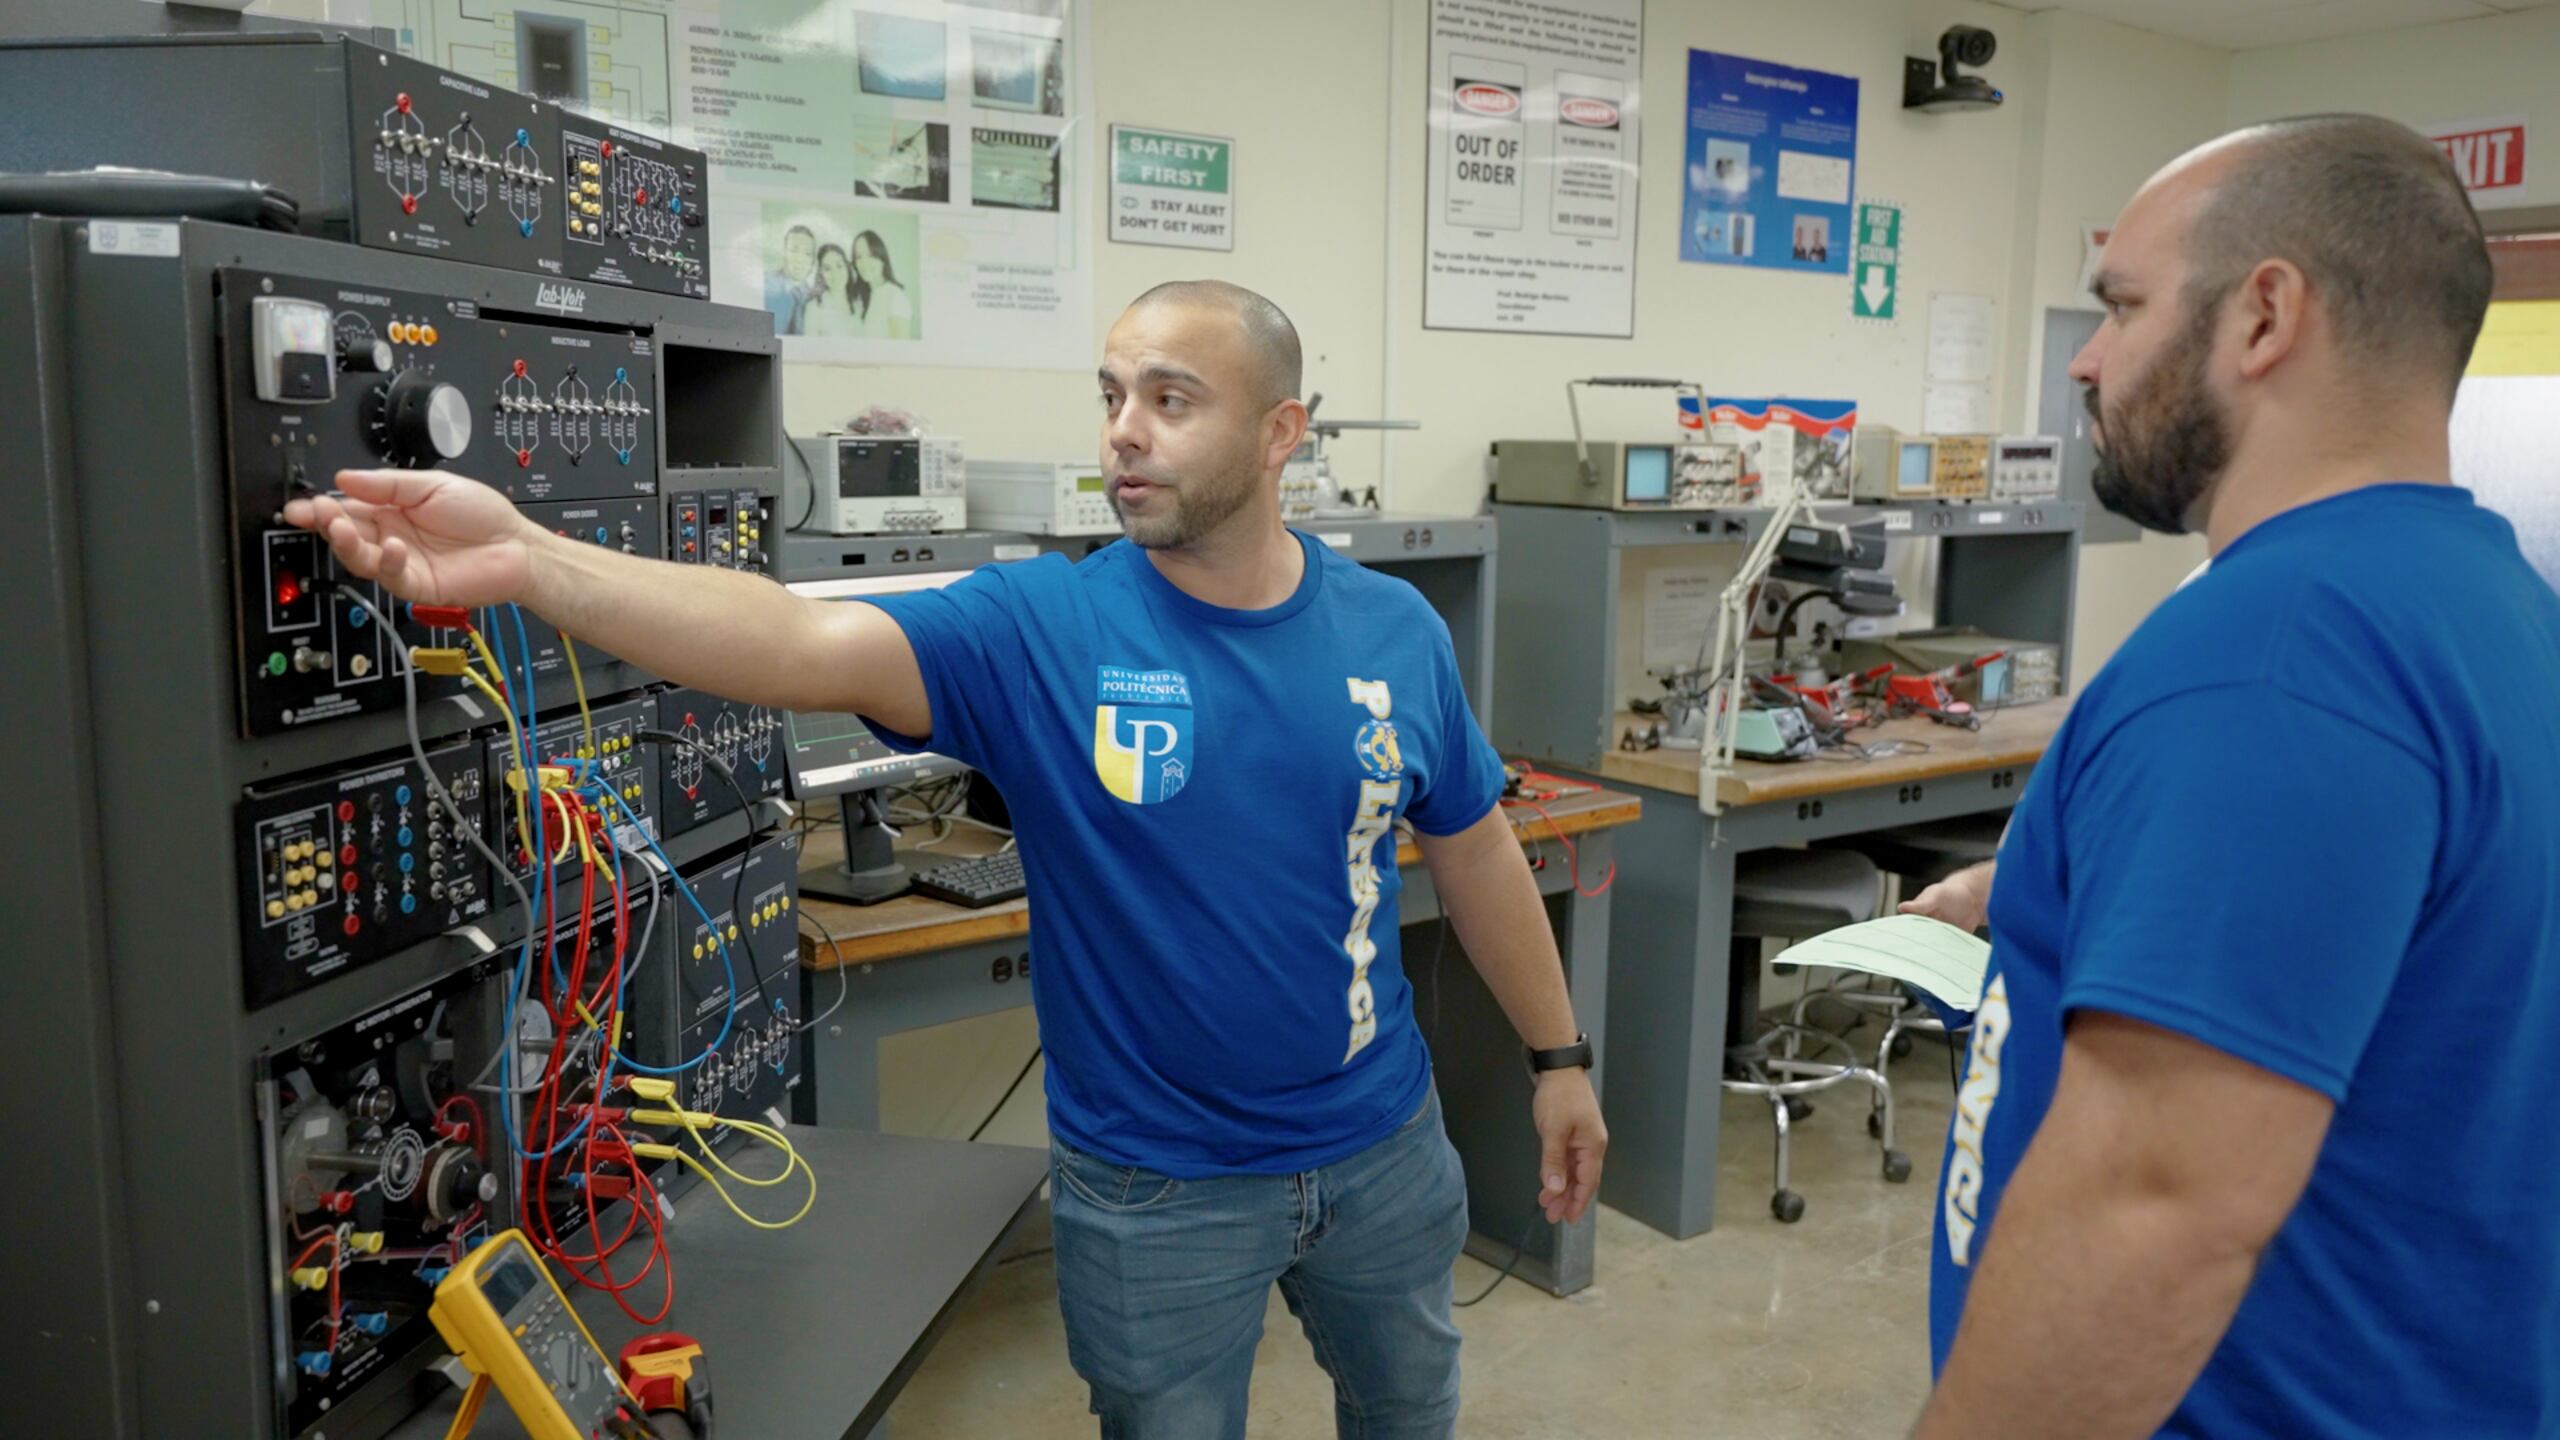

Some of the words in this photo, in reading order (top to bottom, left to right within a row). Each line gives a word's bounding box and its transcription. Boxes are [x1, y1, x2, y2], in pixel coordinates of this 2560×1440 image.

[1129, 136, 1219, 162] SAFETY
[1456, 133, 1492, 157] OUT
[1497, 139, 1518, 160] OF
[2434, 131, 2513, 187] XIT
[1141, 165, 1208, 187] FIRST
[1457, 160, 1516, 187] ORDER
[1151, 198, 1182, 213] STAY
[1186, 202, 1226, 217] ALERT
[1119, 215, 1159, 230] DON'T
[1162, 220, 1188, 233] GET
[1191, 222, 1226, 236] HURT
[535, 282, 586, 316] Lab-Volt
[1103, 670, 1186, 684] UNIVERSIDAD
[1103, 681, 1187, 696] POLITÉCNICA
